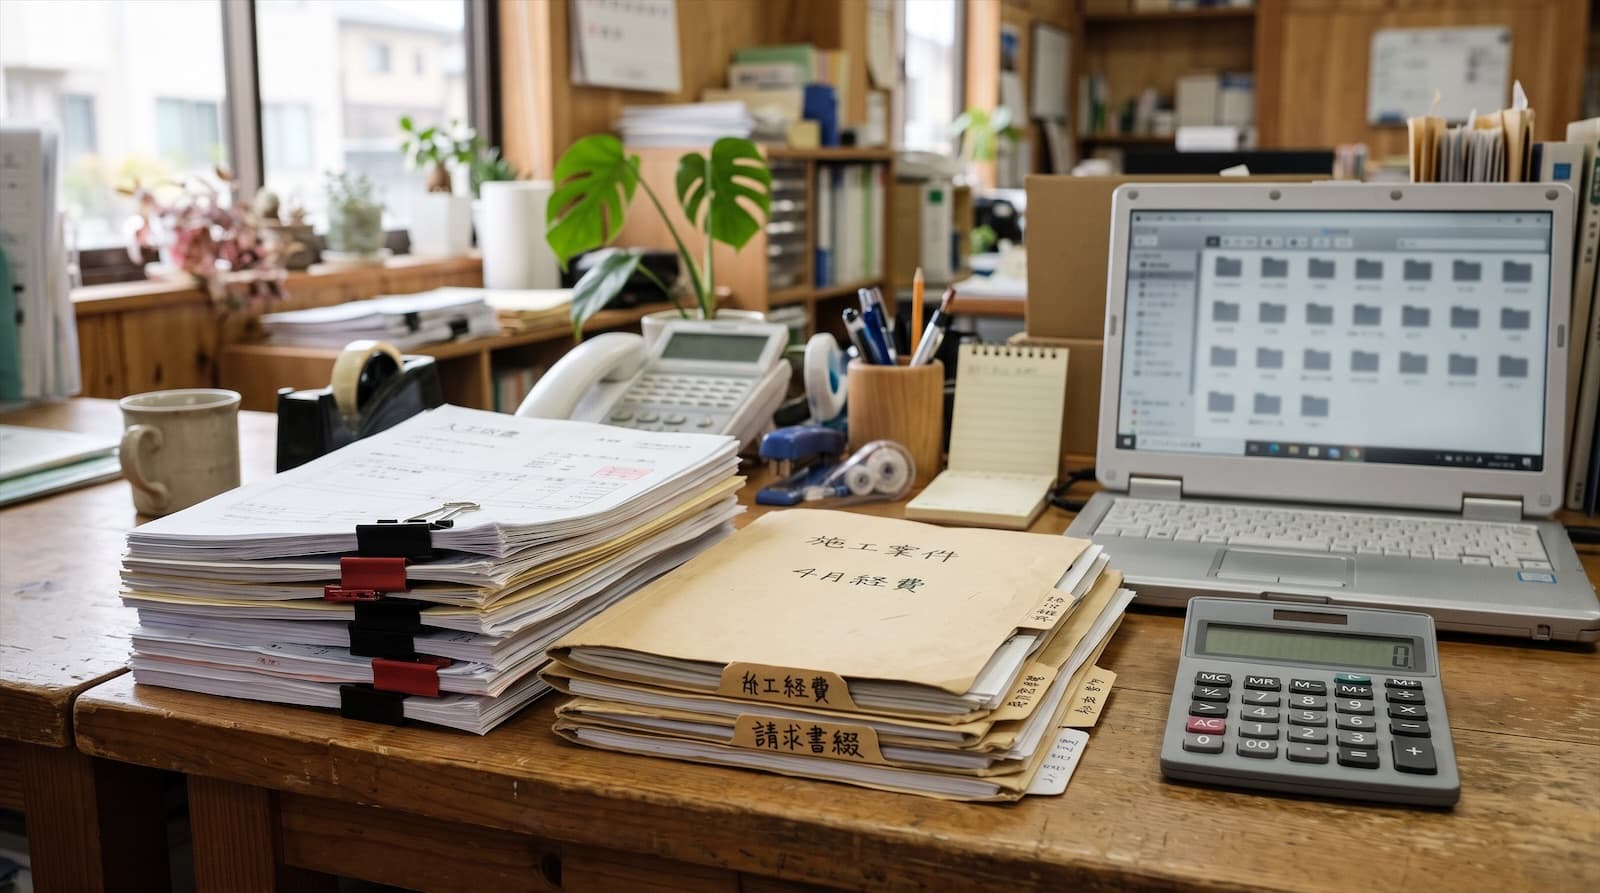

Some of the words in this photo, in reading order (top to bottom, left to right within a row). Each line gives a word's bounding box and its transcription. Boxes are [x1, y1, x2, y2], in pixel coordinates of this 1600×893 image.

[792, 568, 925, 593] 4月経費
[1201, 673, 1227, 681] MC
[1249, 677, 1274, 685] MR
[1342, 685, 1368, 693] M+
[1256, 692, 1267, 700] 7
[1302, 696, 1315, 705] 8
[1350, 700, 1361, 709] 9
[1253, 708, 1267, 716] 4
[1304, 712, 1314, 720] 5
[1194, 720, 1219, 728] AC
[1351, 716, 1362, 725] 6
[1256, 724, 1262, 733] 1
[1302, 728, 1314, 738] 2
[752, 720, 864, 759] 請求書綴
[1197, 736, 1210, 744] 0
[1351, 733, 1364, 742] 3
[1246, 740, 1269, 749] 00
